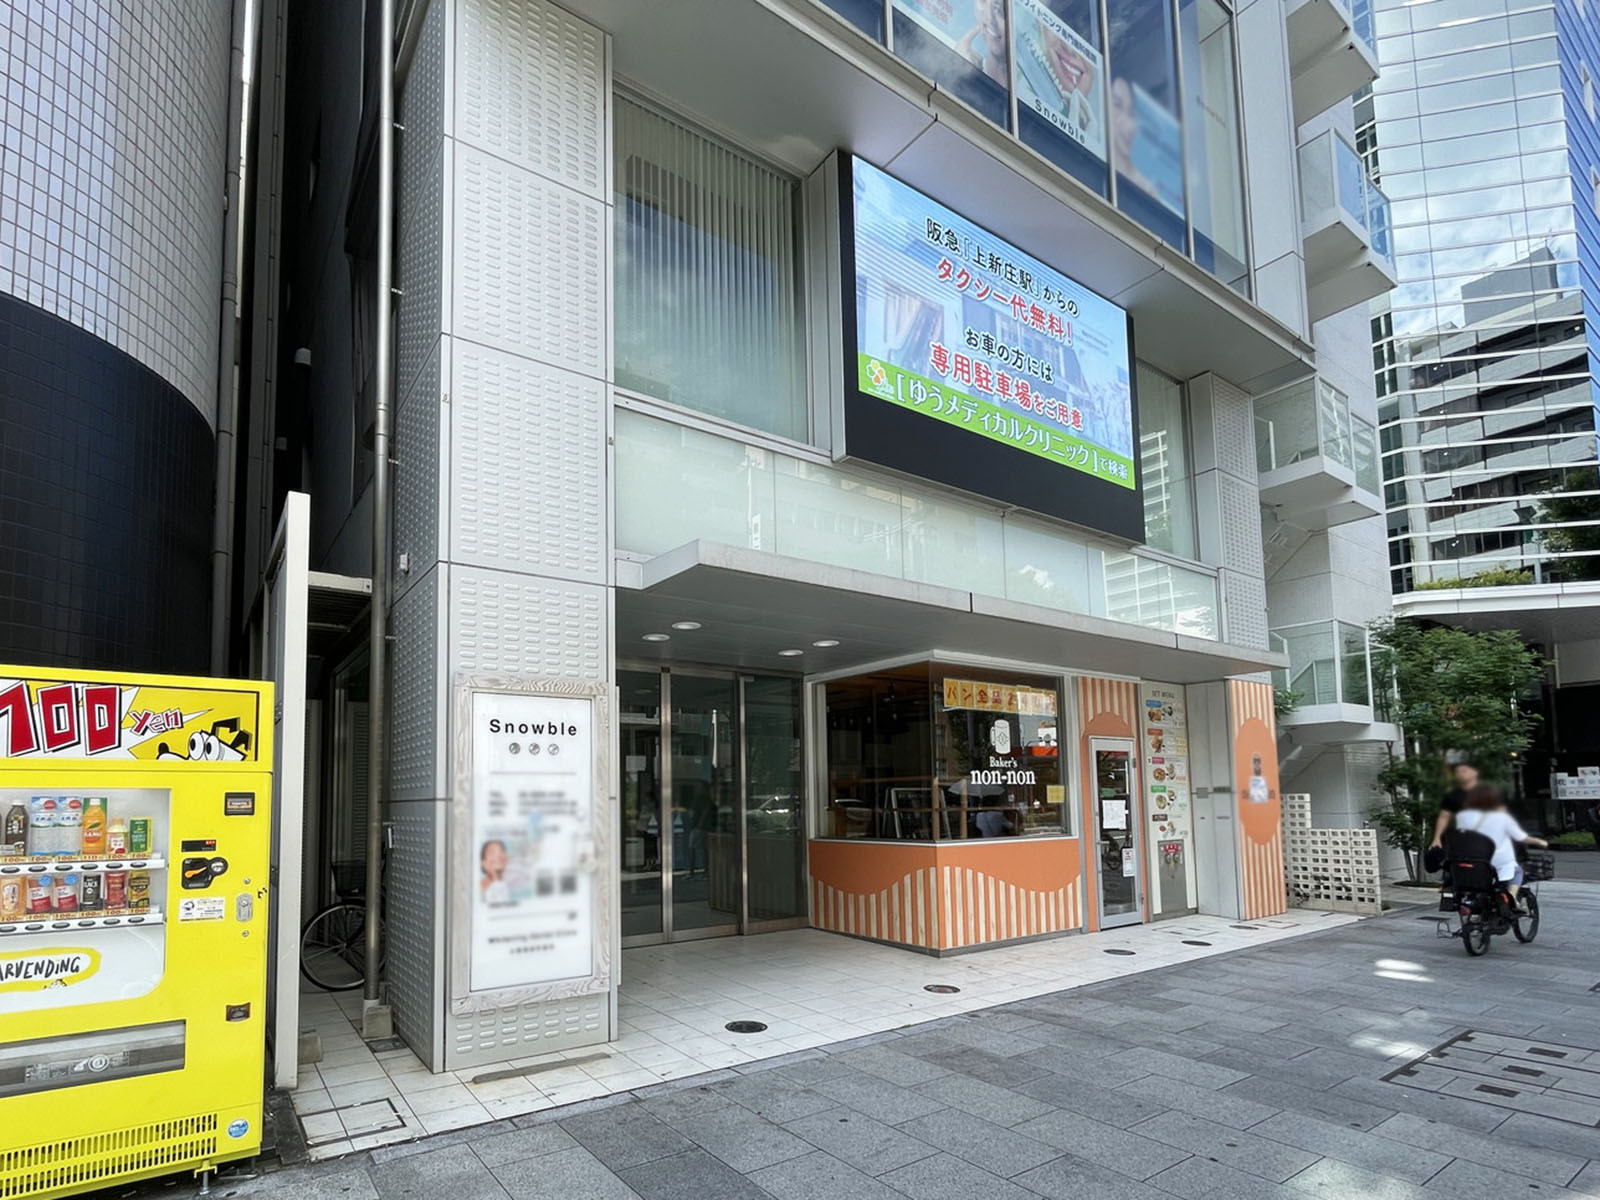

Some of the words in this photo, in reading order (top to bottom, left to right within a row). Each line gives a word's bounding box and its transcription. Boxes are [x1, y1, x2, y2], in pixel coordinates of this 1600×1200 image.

[1034, 98, 1086, 144] Snowble
[965, 328, 1054, 382] お車の方には
[929, 342, 1083, 430] 専用駐車場をご用意
[0, 682, 122, 758] 100
[489, 719, 577, 736] Snowble
[970, 769, 1036, 785] non-non
[989, 756, 1018, 768] Baker's
